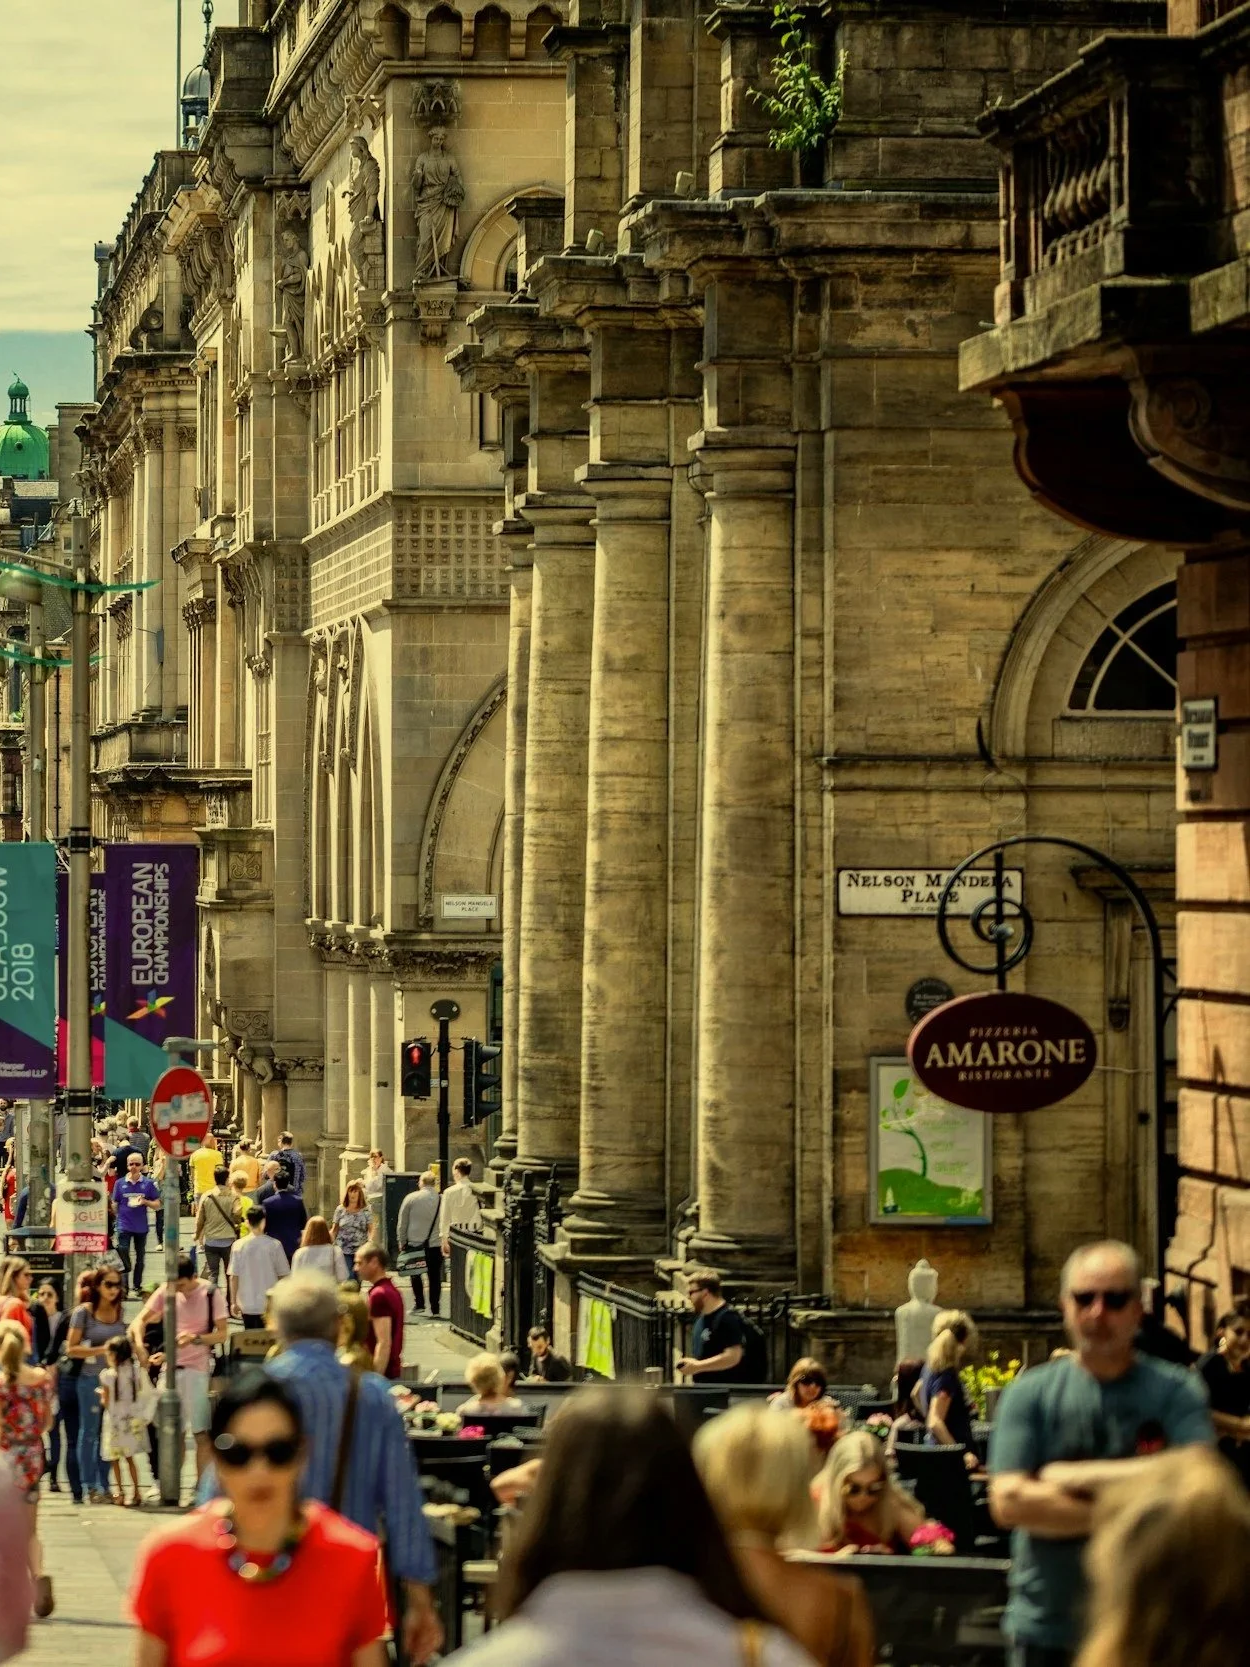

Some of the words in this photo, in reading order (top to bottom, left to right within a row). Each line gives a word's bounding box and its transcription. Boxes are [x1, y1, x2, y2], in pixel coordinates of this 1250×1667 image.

[847, 873, 916, 888] NELSON
[901, 889, 960, 903] PLACE
[132, 862, 153, 985] EUROPEAN
[154, 862, 170, 985] CHAMPIONSHIPS
[11, 943, 34, 1001] 2018
[969, 1026, 1038, 1038] PIZZERIA
[924, 1038, 1087, 1069] AMARONE
[958, 1067, 1051, 1082] RISTORANTE
